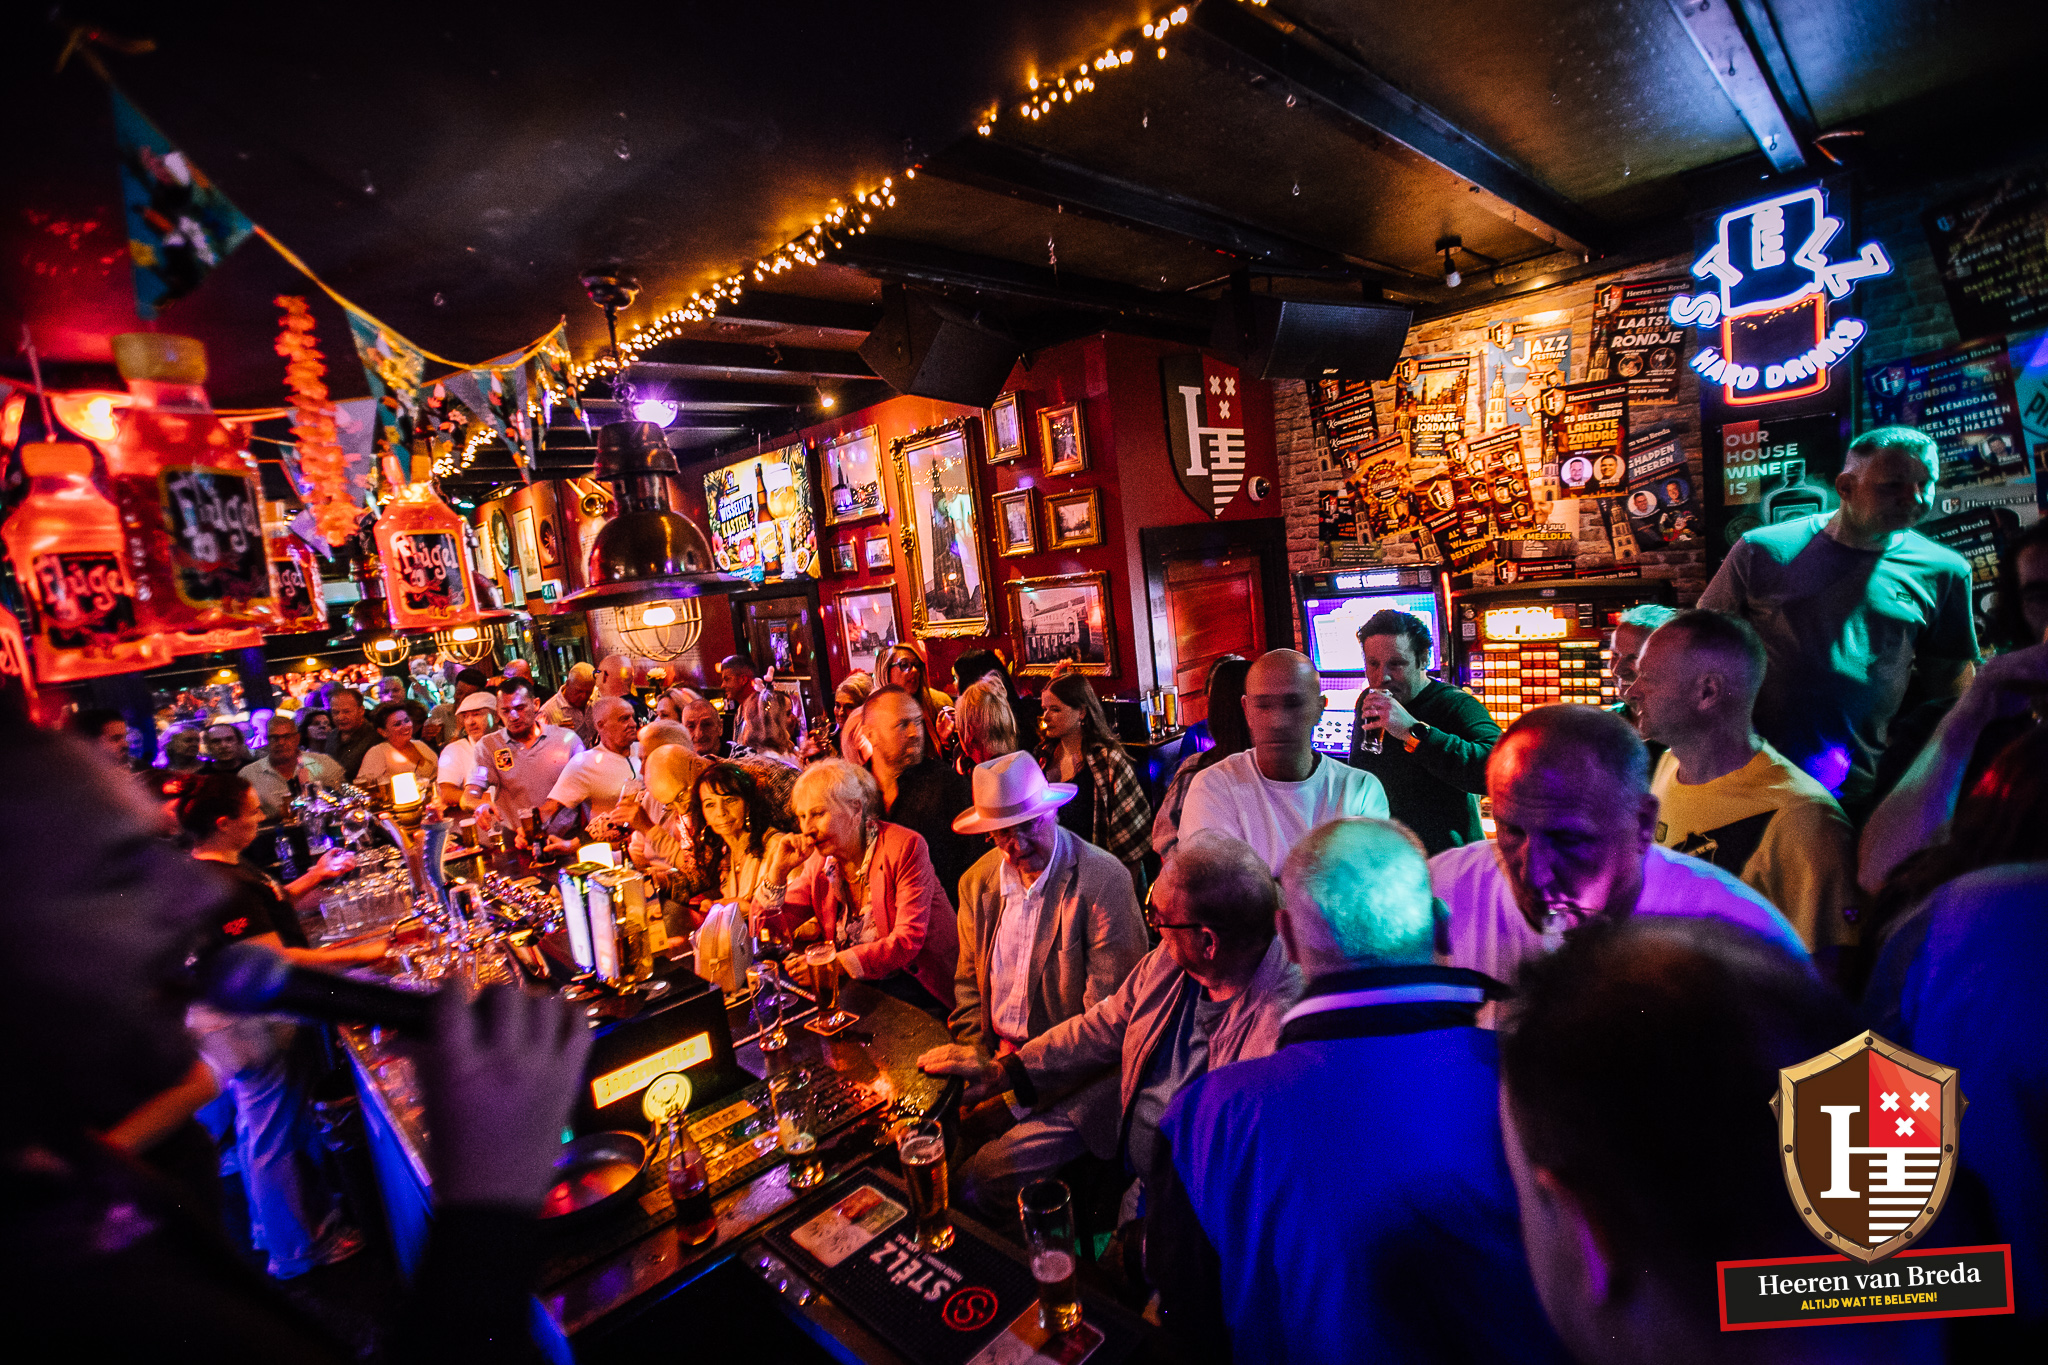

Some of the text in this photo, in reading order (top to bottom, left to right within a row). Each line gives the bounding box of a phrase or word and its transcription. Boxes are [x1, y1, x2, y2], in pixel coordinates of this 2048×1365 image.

[1618, 315, 1674, 330] LAATST
[1636, 325, 1671, 334] EERSTE
[1611, 331, 1684, 348] RONDJE
[1511, 335, 1569, 367] JAZZ
[1532, 351, 1567, 361] FESTIVAL
[1690, 348, 1759, 390] HARD
[1765, 319, 1865, 389] DRINKS
[1911, 357, 1948, 375] Heeren
[1949, 355, 1968, 365] van
[1970, 344, 2002, 359] Breda
[1567, 393, 1592, 402] Heeren
[1605, 386, 1626, 395] Breda
[1907, 384, 1957, 403] ZONDAG
[1983, 371, 2007, 384] MEI
[1417, 413, 1456, 423] RONDJE
[1577, 409, 1623, 422] DECEMBER
[1918, 404, 2011, 433] HEEL DE HEEREN
[1412, 422, 1459, 433] JORDAAN
[1567, 418, 1619, 434] LAATSTE
[1928, 417, 2004, 440] ZINGT HAZES
[1568, 429, 1618, 445] ZONDAG
[1725, 430, 1769, 447] OUR
[1726, 443, 1799, 464] HOUSE
[1633, 454, 1674, 477] HEEREN
[1725, 461, 1782, 480] WINE
[1729, 482, 1748, 496] IS
[721, 513, 750, 538] KASTEEL
[1941, 519, 1991, 539] van Breda
[1504, 532, 1573, 541] DIRK MEELDIJK
[396, 532, 460, 580] Flügel
[1450, 541, 1487, 561] BELEVEN!
